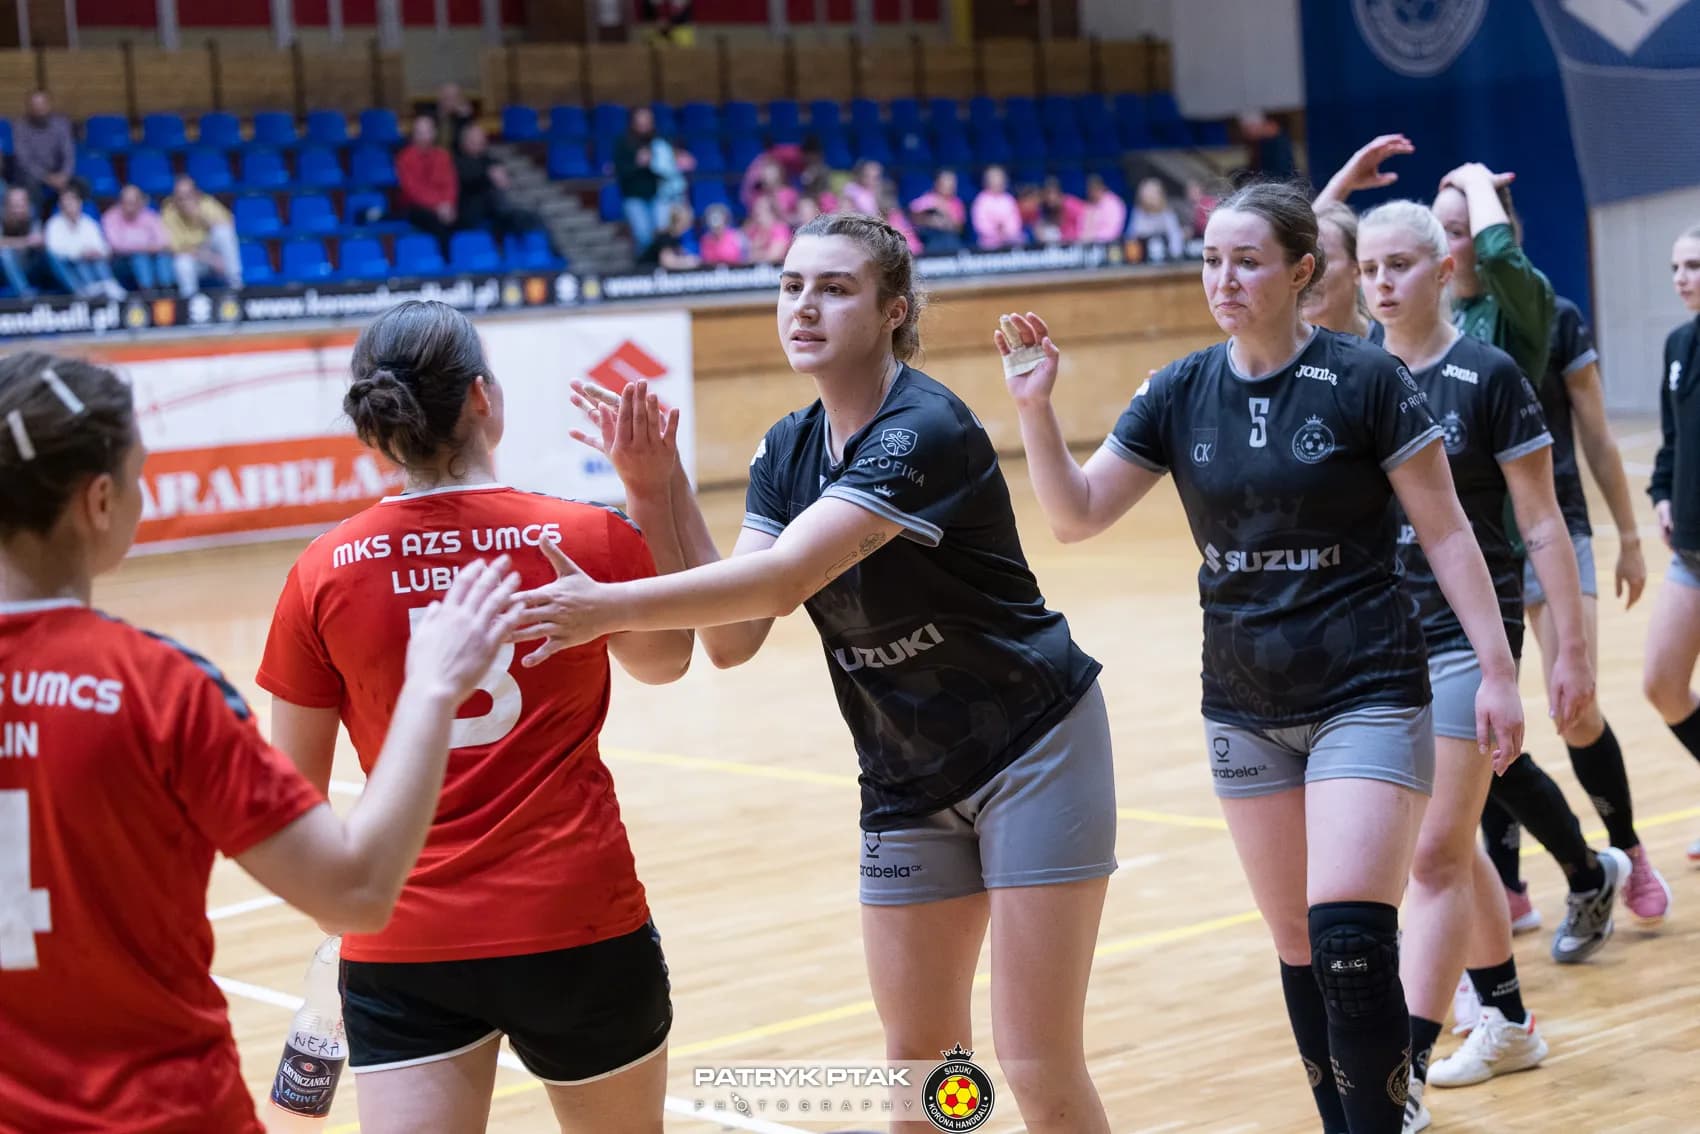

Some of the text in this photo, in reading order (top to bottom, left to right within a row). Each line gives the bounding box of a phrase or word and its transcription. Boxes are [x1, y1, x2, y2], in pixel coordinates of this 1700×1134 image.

[1248, 397, 1270, 448] 5
[1194, 443, 1212, 463] CK
[333, 523, 563, 569] MKS AZS UMCS
[1225, 543, 1341, 574] SUZUKI
[391, 565, 462, 594] LUB
[834, 622, 945, 672] UZUKI
[11, 670, 124, 715] UMCS
[0, 720, 39, 759] IN
[860, 864, 910, 878] rabela
[284, 1088, 318, 1104] ACTIVE
